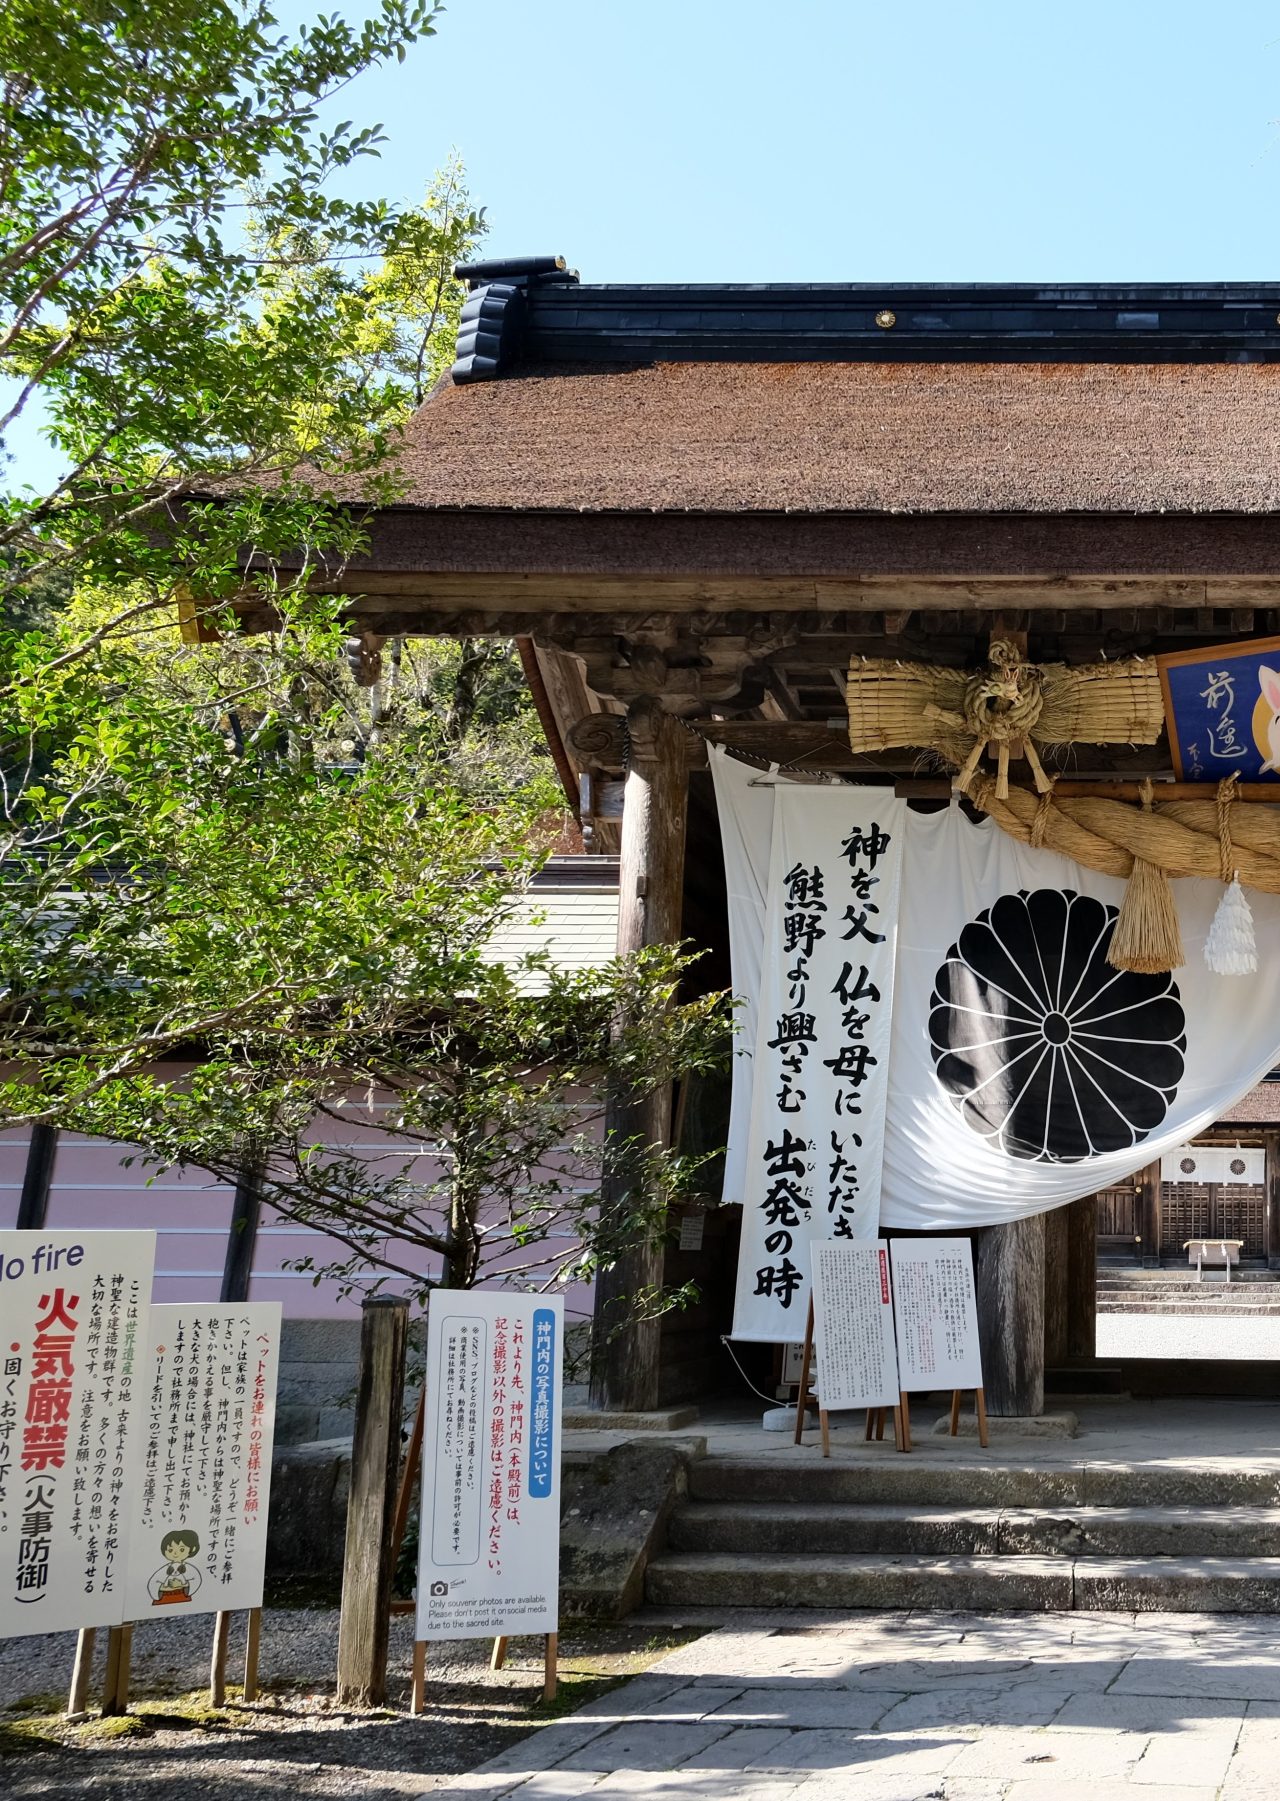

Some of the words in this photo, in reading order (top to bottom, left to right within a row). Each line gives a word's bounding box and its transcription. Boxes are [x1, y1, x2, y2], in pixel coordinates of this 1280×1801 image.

[837, 822, 892, 944] 神を父
[767, 863, 828, 1114] 熊野より興さむ
[823, 961, 881, 1116] 仏を母に
[31, 1243, 85, 1275] fire
[753, 1128, 812, 1310] 出発の時
[803, 1138, 817, 1222] たびだち
[161, 1319, 185, 1523] しますので社務所まで申し出て下さい。
[179, 1319, 203, 1525] 大きな犬の場合には、神社にてお預かり
[196, 1318, 220, 1497] 抱きかかえる事を厳守して下さい。
[243, 1332, 270, 1526] ペットをお連れの皆様にお願い
[488, 1316, 508, 1576] 記念撮影以外の撮影はご遠慮ください。
[506, 1319, 525, 1526] これより先、神門内（本殿前）は、
[533, 1321, 552, 1485] 神門内の写真撮影について
[427, 1621, 441, 1630] due
[442, 1621, 451, 1629] to
[452, 1620, 465, 1629] the
[466, 1618, 490, 1628] sacred
[428, 1609, 453, 1619] Please
[454, 1608, 473, 1617] don't
[474, 1608, 489, 1617] post
[491, 1606, 497, 1615] it
[507, 1605, 526, 1615] social
[527, 1605, 547, 1613] media
[429, 1599, 446, 1610] Only
[447, 1599, 477, 1608] souvenir
[478, 1596, 503, 1607] photos
